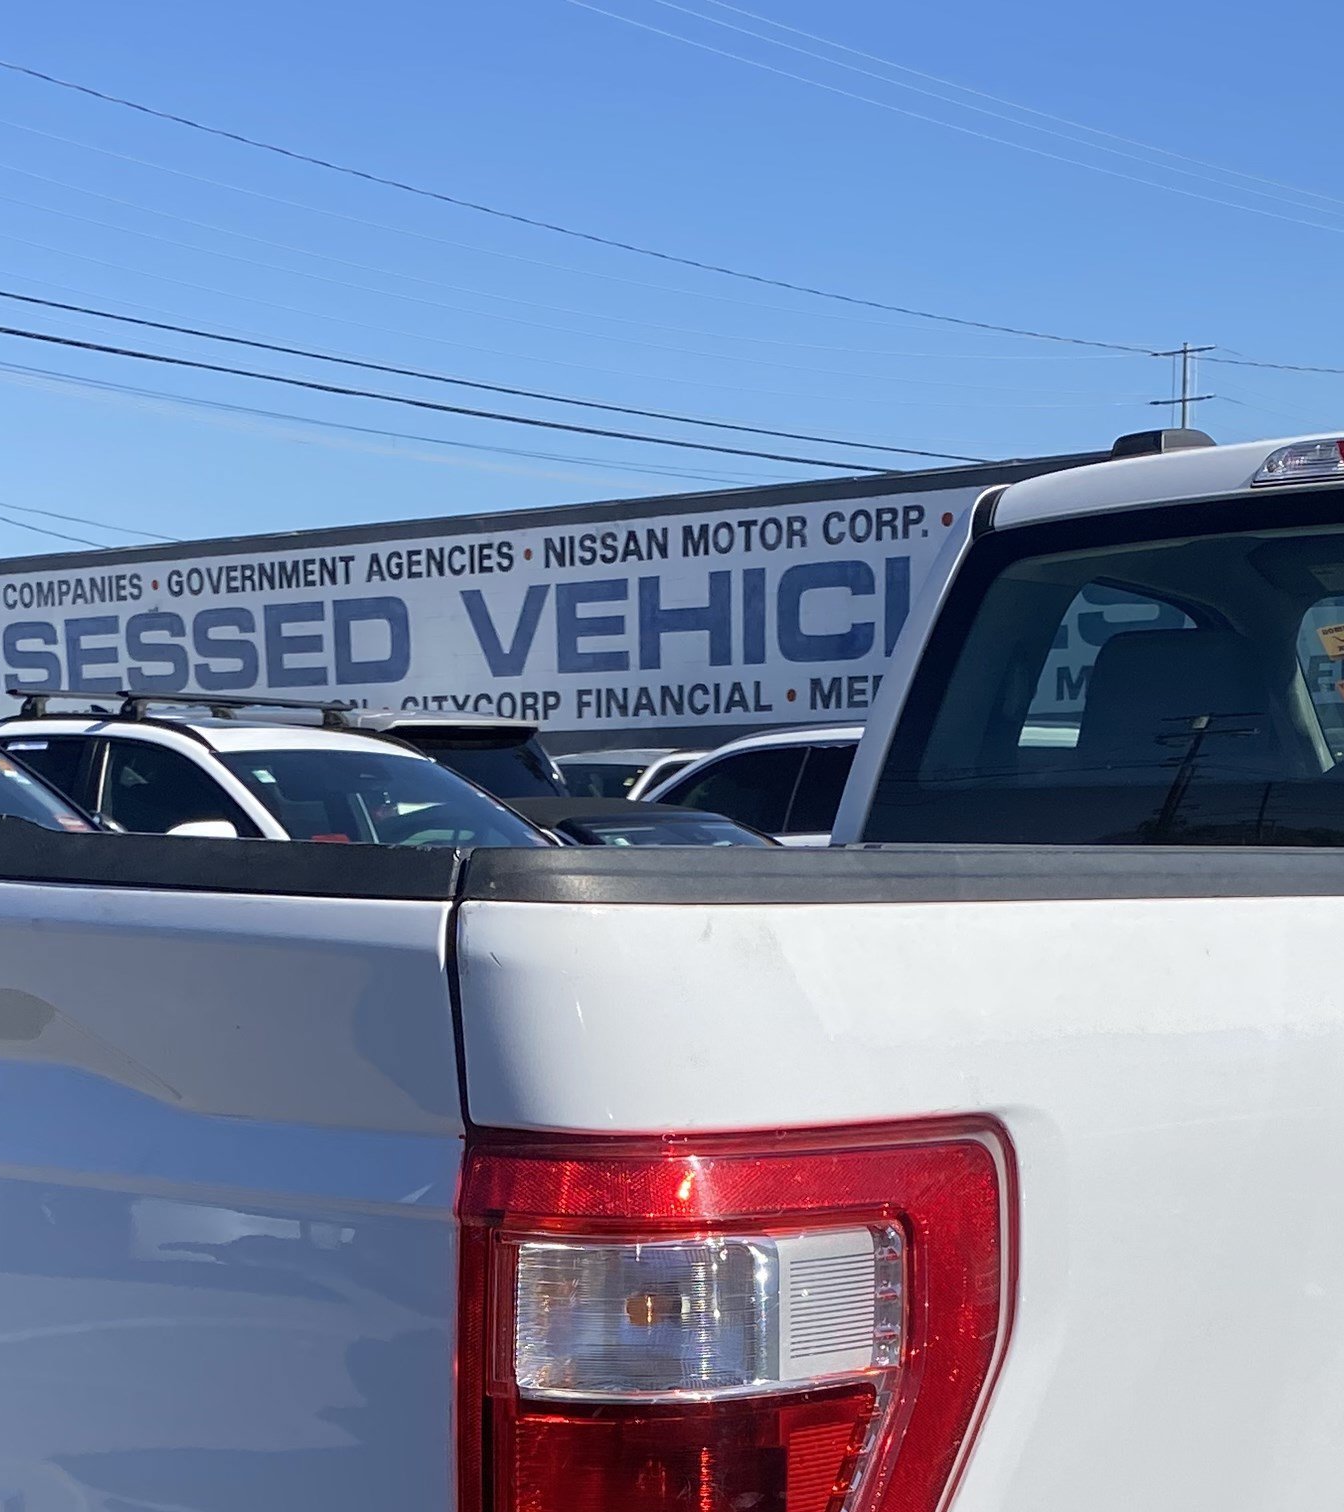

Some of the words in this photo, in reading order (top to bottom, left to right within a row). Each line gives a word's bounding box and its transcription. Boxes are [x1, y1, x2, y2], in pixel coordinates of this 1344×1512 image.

[2, 573, 143, 610] COMPANIES
[167, 554, 355, 598] GOVERNMENT
[365, 541, 514, 583] AGENCIES
[543, 526, 668, 568] NISSAN
[682, 514, 808, 559] MOTOR
[822, 504, 929, 546] CORP.
[576, 681, 773, 719] FINANCIAL
